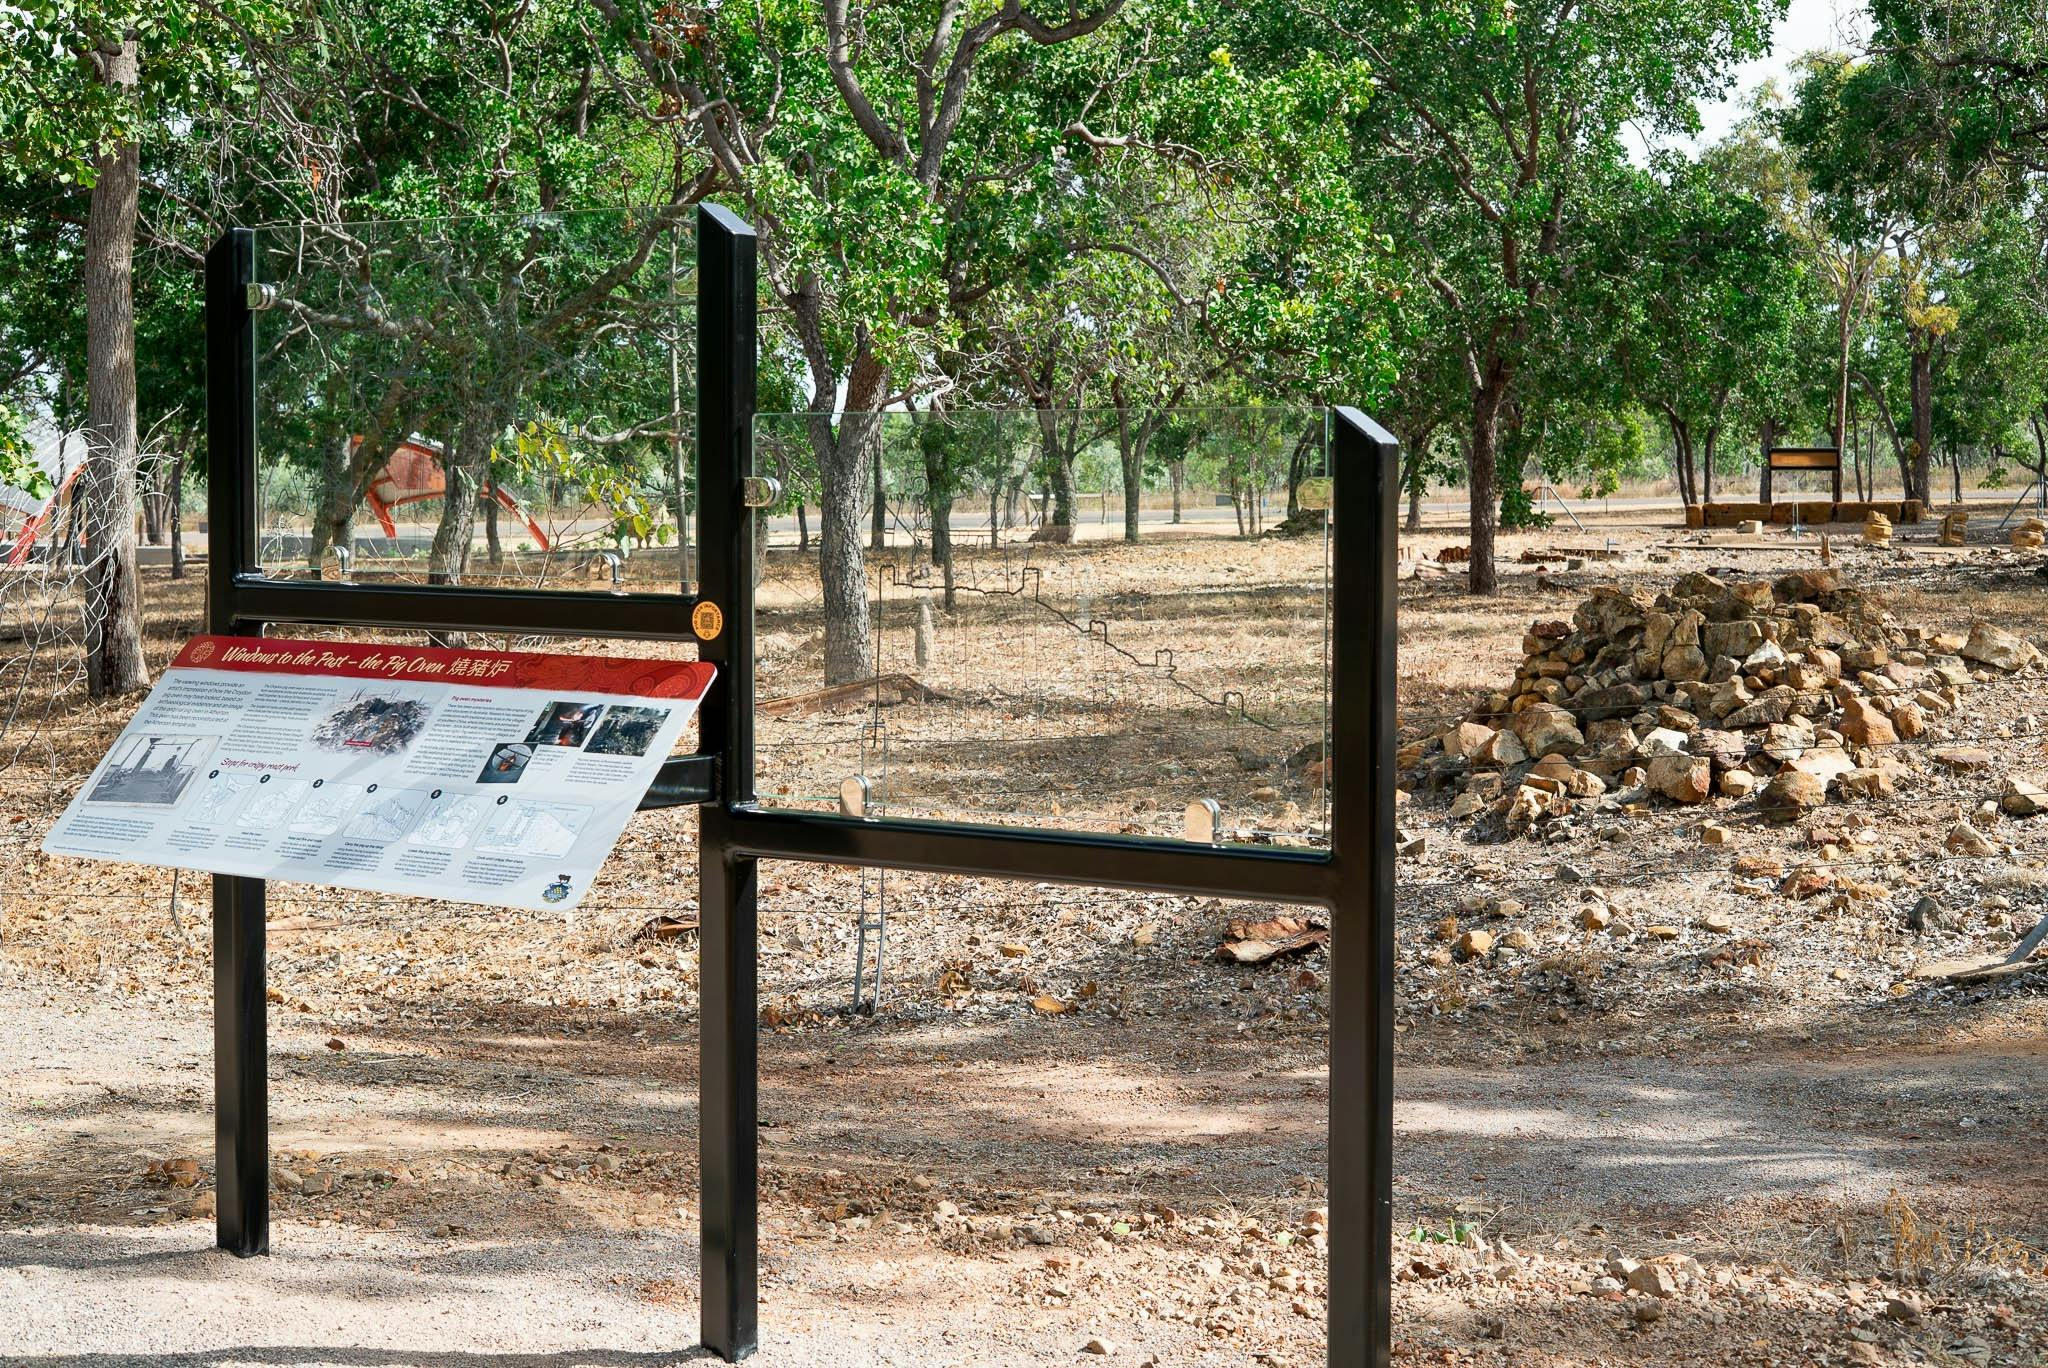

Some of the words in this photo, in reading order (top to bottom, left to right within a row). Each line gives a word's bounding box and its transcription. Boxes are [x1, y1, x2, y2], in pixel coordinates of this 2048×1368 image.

[221, 646, 279, 665] Windows
[277, 651, 293, 664] to
[292, 649, 316, 666] the
[314, 651, 350, 669] Past
[359, 653, 383, 669] the
[381, 655, 408, 677] Pig
[407, 657, 446, 673] Oven
